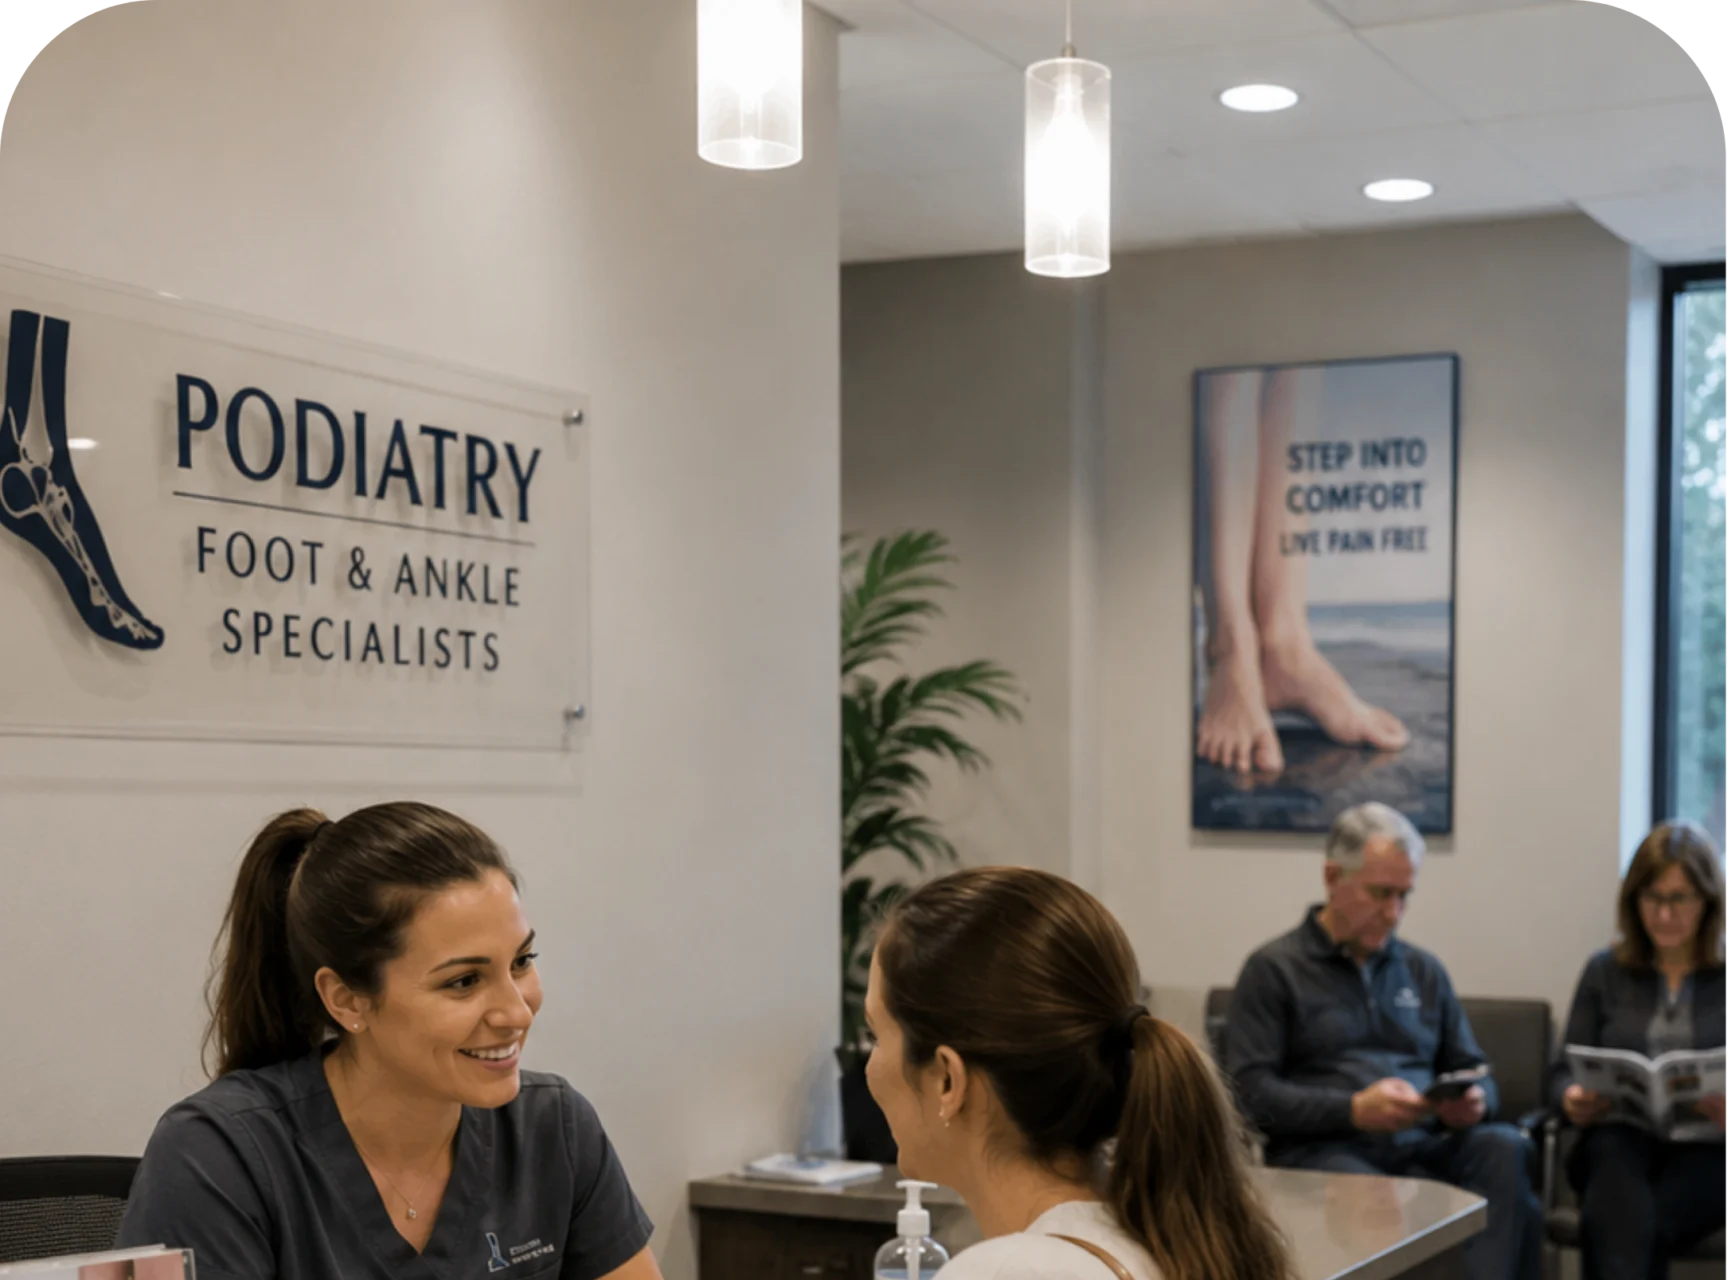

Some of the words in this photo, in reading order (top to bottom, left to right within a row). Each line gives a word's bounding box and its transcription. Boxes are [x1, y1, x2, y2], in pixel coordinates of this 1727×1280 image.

[175, 373, 542, 523] PODIATRY
[1287, 441, 1352, 473] STEP
[1360, 437, 1427, 469] INTO
[1286, 482, 1426, 514] COMFORT
[197, 526, 325, 585] FOOT
[348, 546, 373, 592] &
[394, 554, 520, 606] ANKLE
[1280, 531, 1320, 556] LIVE
[222, 608, 501, 672] SPECIALISTS
